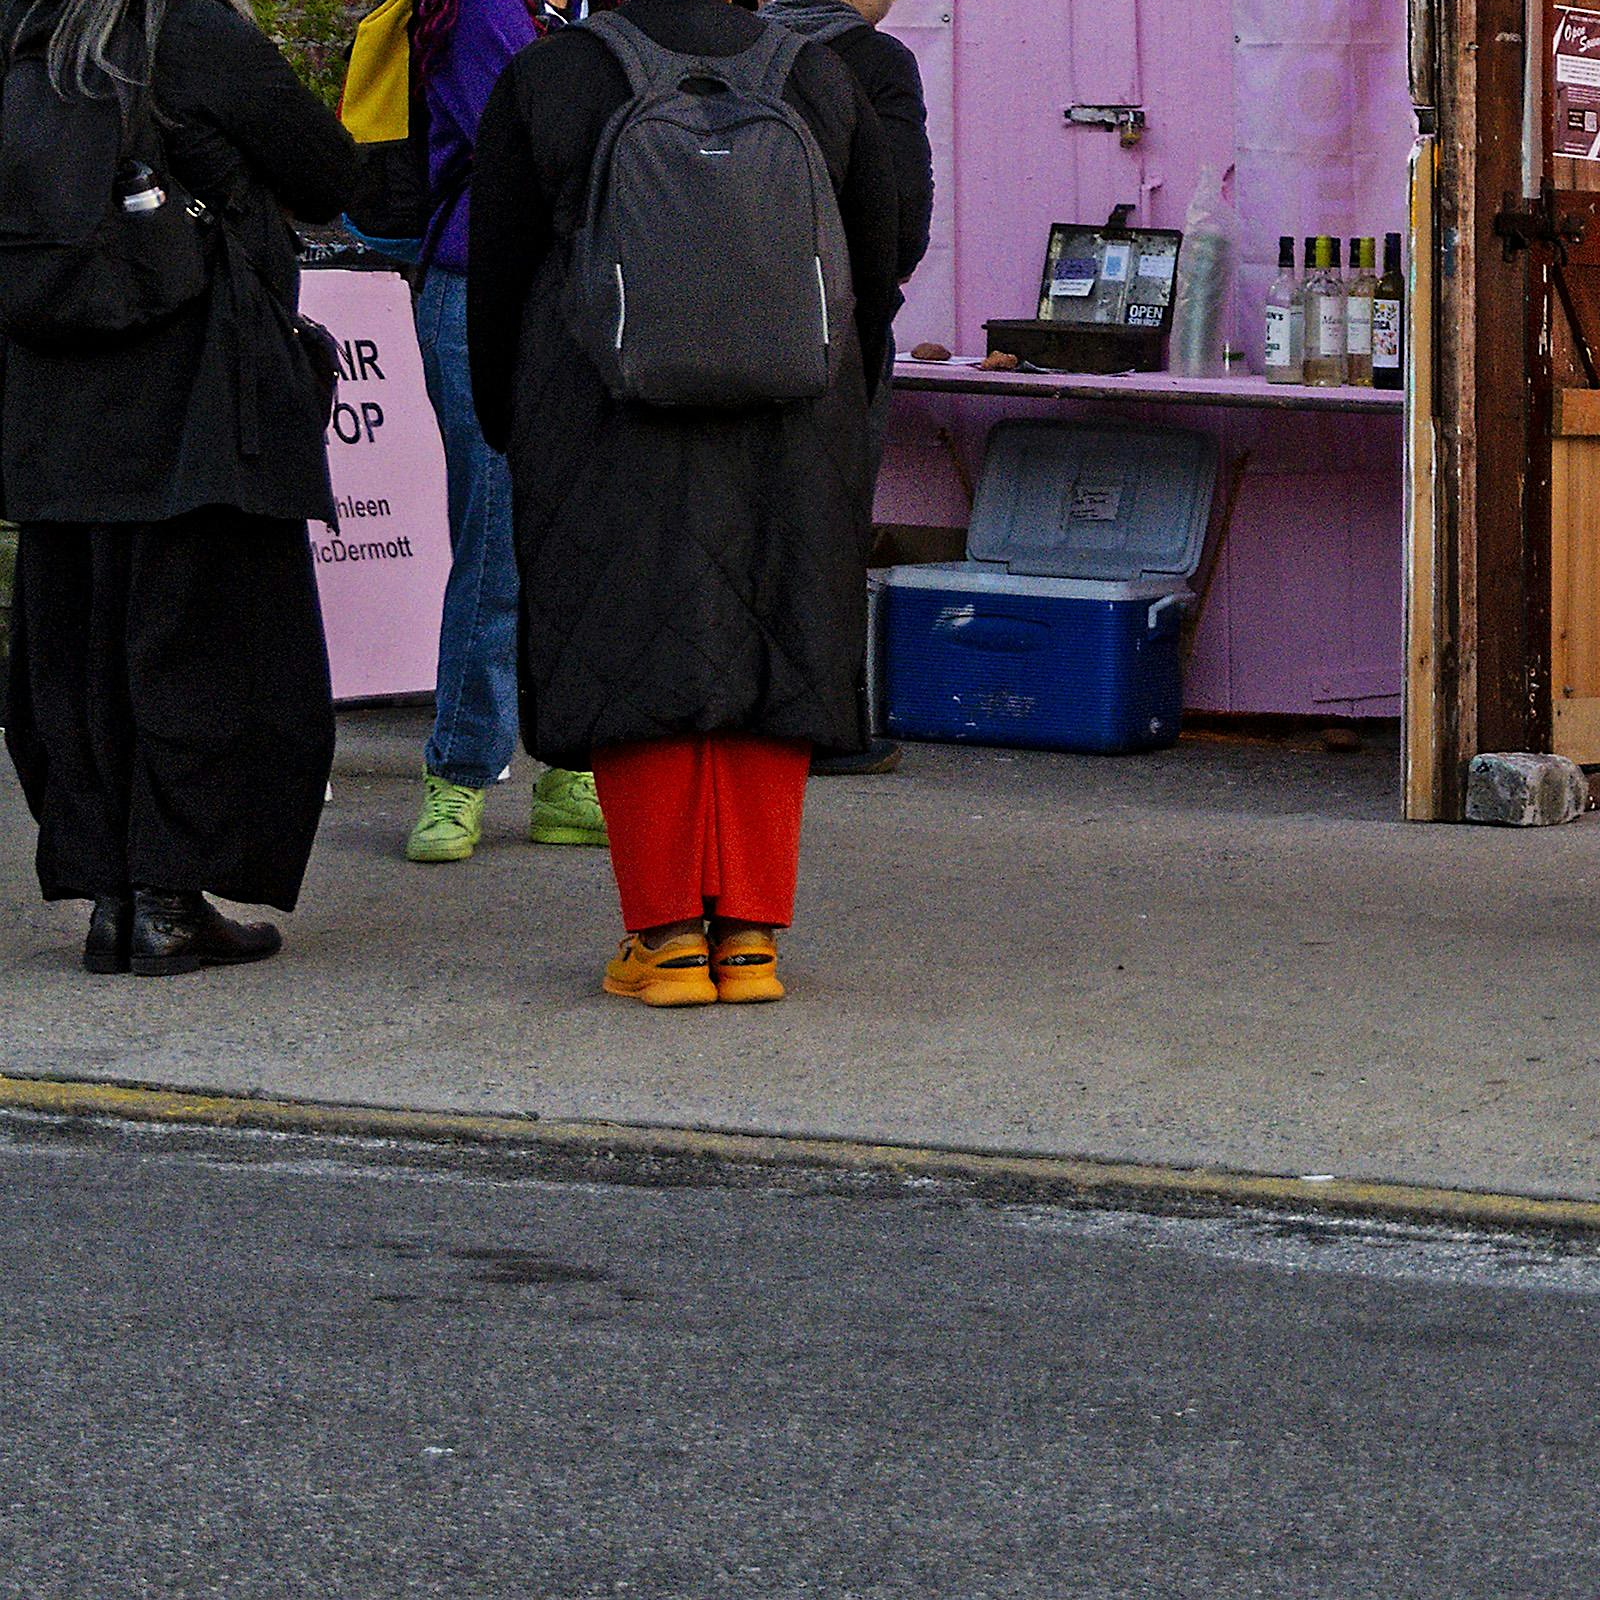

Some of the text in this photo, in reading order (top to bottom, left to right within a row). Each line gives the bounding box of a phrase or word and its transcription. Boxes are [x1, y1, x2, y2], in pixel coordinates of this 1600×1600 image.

[1129, 304, 1164, 319] OPEN
[325, 400, 385, 445] OP
[334, 495, 391, 518] hleen
